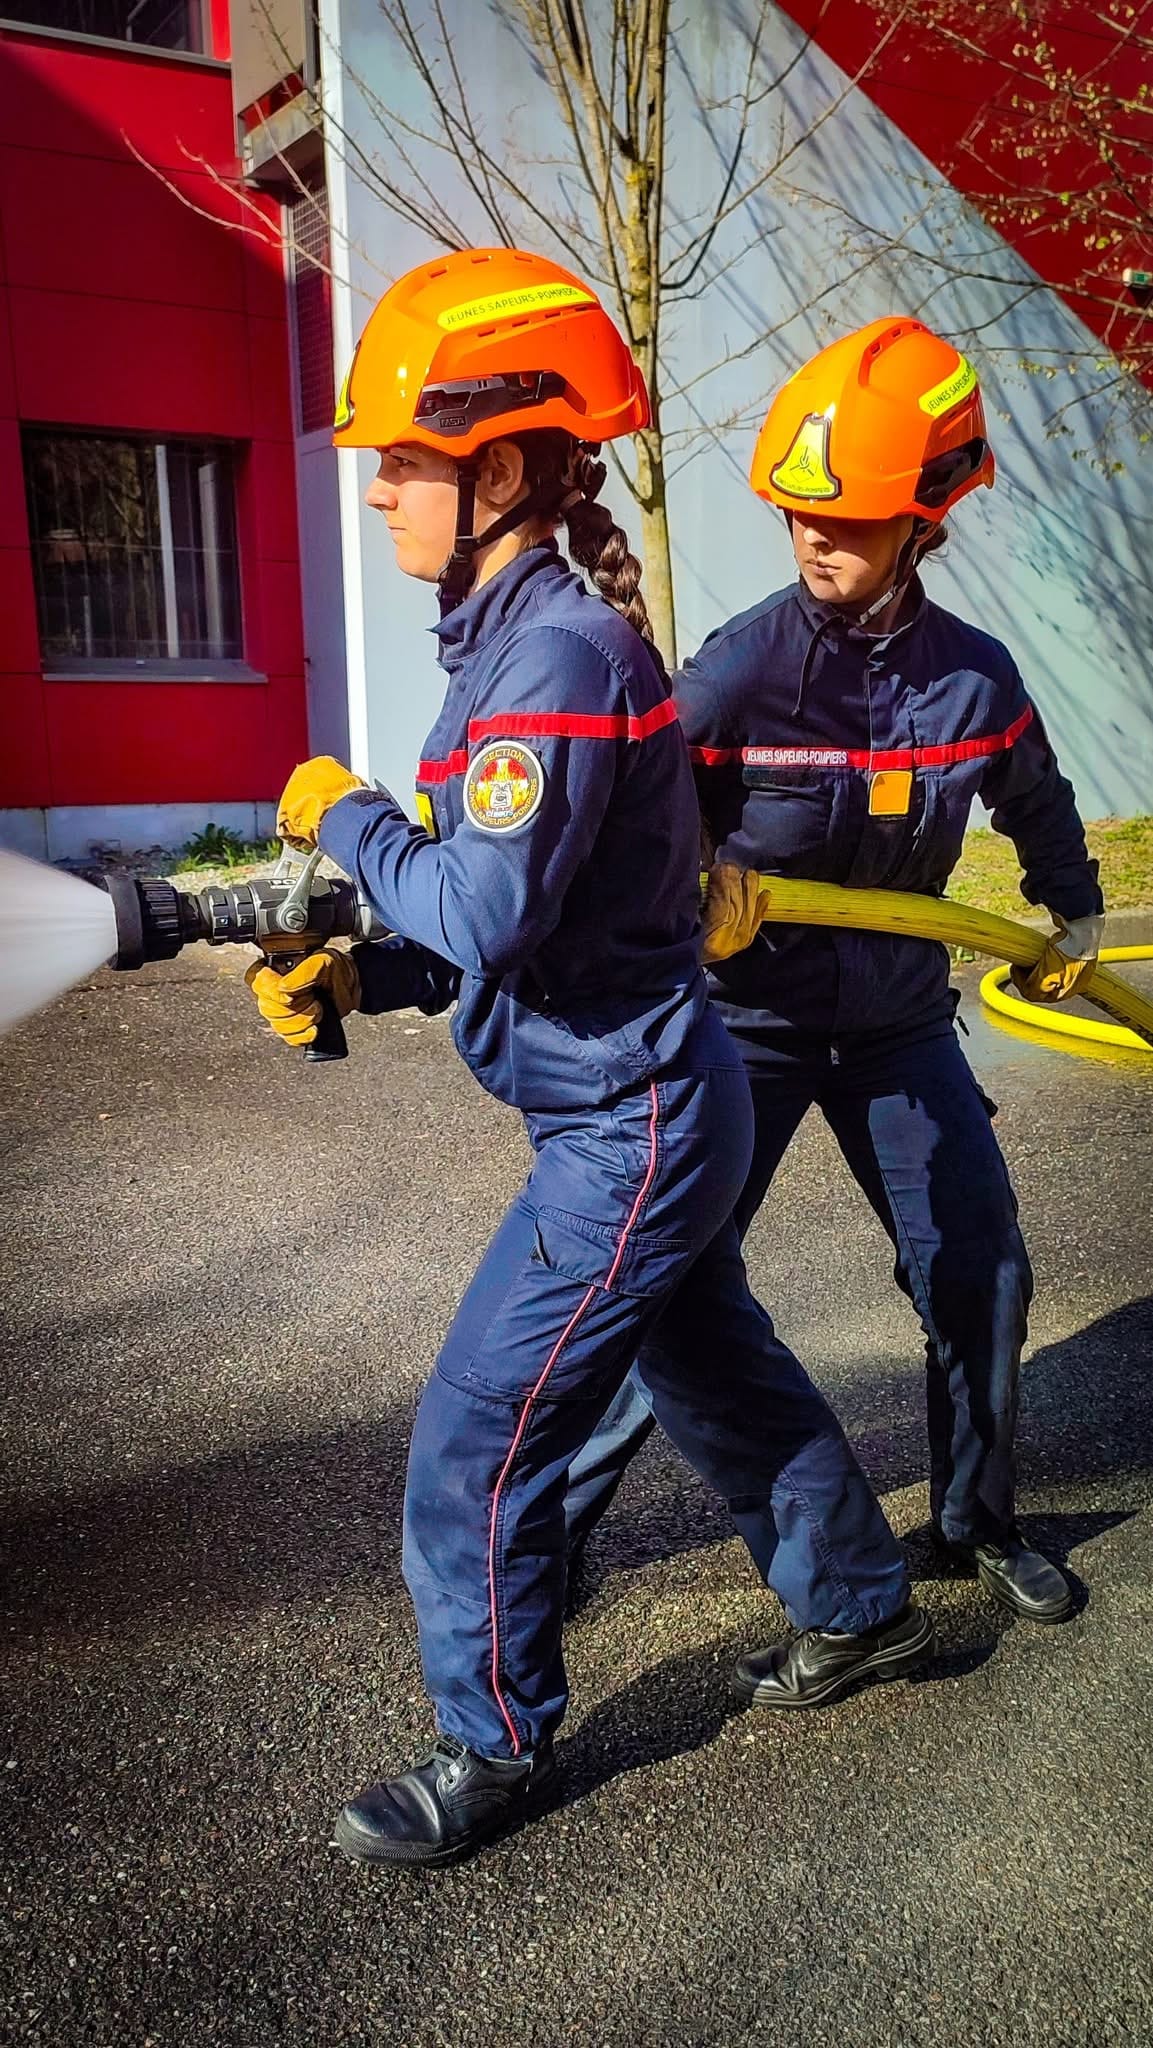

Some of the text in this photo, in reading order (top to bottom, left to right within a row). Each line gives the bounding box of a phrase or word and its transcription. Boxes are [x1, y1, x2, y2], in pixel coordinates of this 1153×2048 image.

[446, 305, 486, 325] JEUNES
[928, 389, 952, 412] JEUNES
[440, 416, 466, 428] MSA
[483, 748, 525, 765] SECTION
[747, 749, 848, 765] JEUNES SAPEURS-POMPIERS
